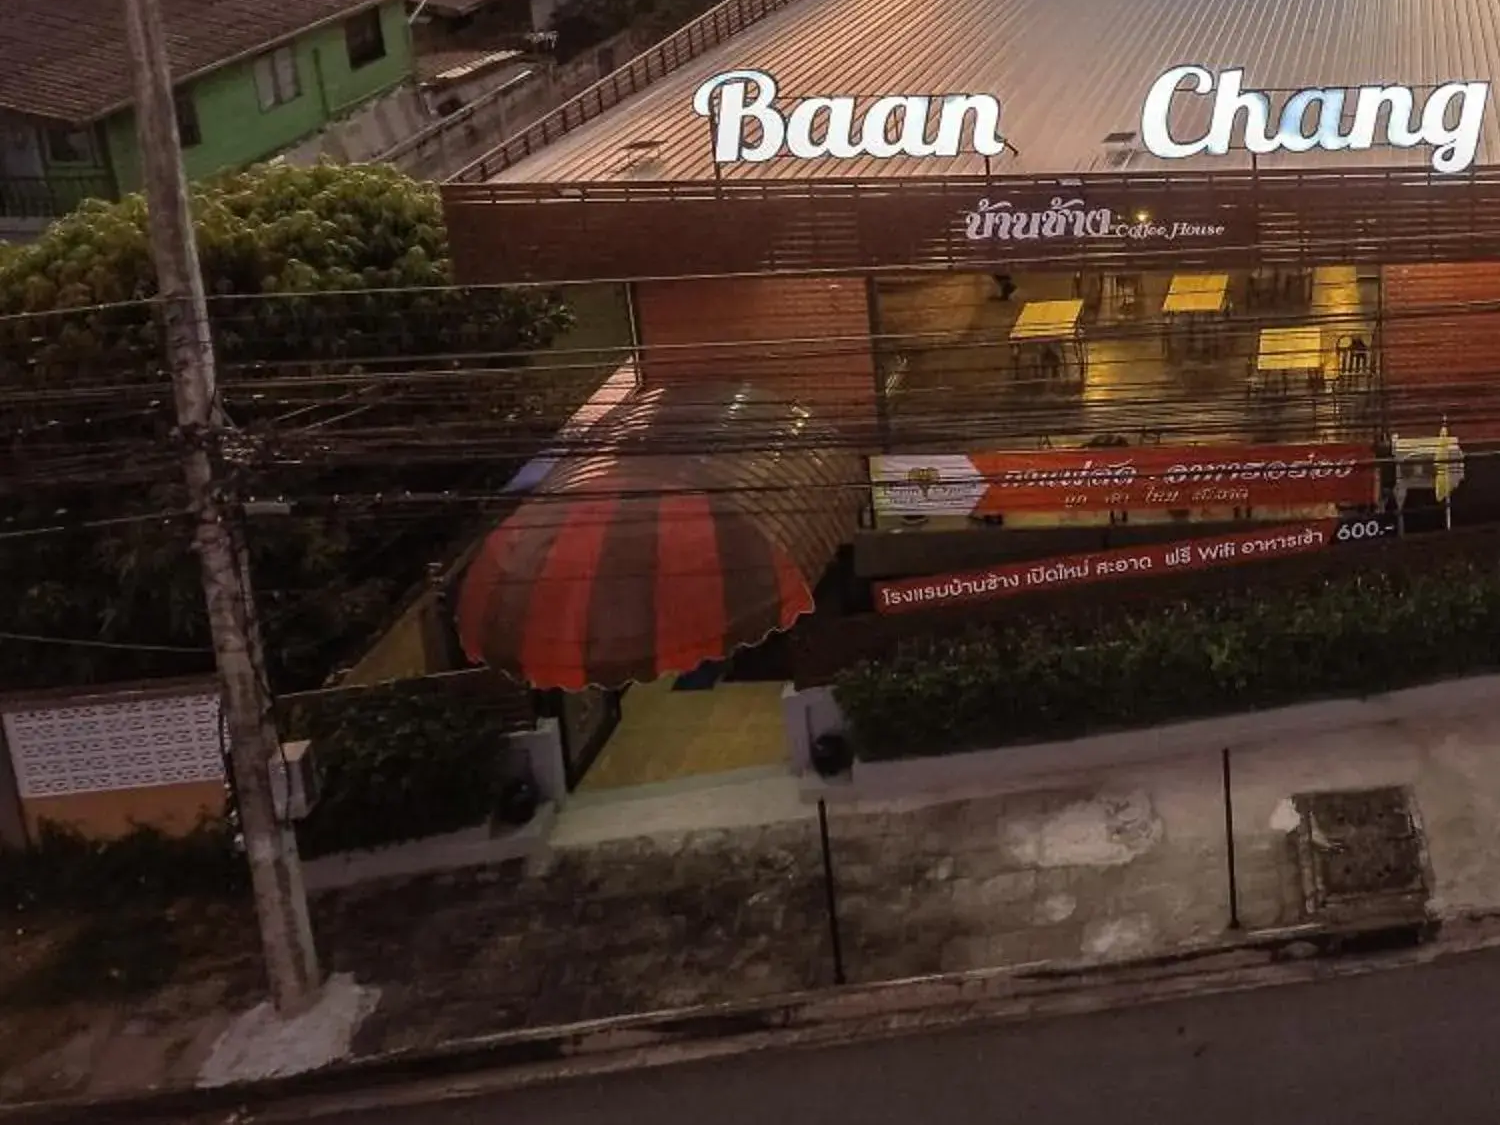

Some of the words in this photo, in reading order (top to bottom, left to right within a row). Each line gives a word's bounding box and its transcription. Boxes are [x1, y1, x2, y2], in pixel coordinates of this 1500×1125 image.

[691, 67, 1005, 164] Baan
[1140, 64, 1490, 175] Chang
[965, 197, 1112, 240] บ้านช้าง
[1167, 222, 1225, 241] House
[881, 572, 1020, 606] โรงแรมบ้านช้าง
[1026, 559, 1090, 585] เปิดใหม่
[1165, 546, 1191, 567] ฟรี
[1197, 542, 1236, 561] Wifi
